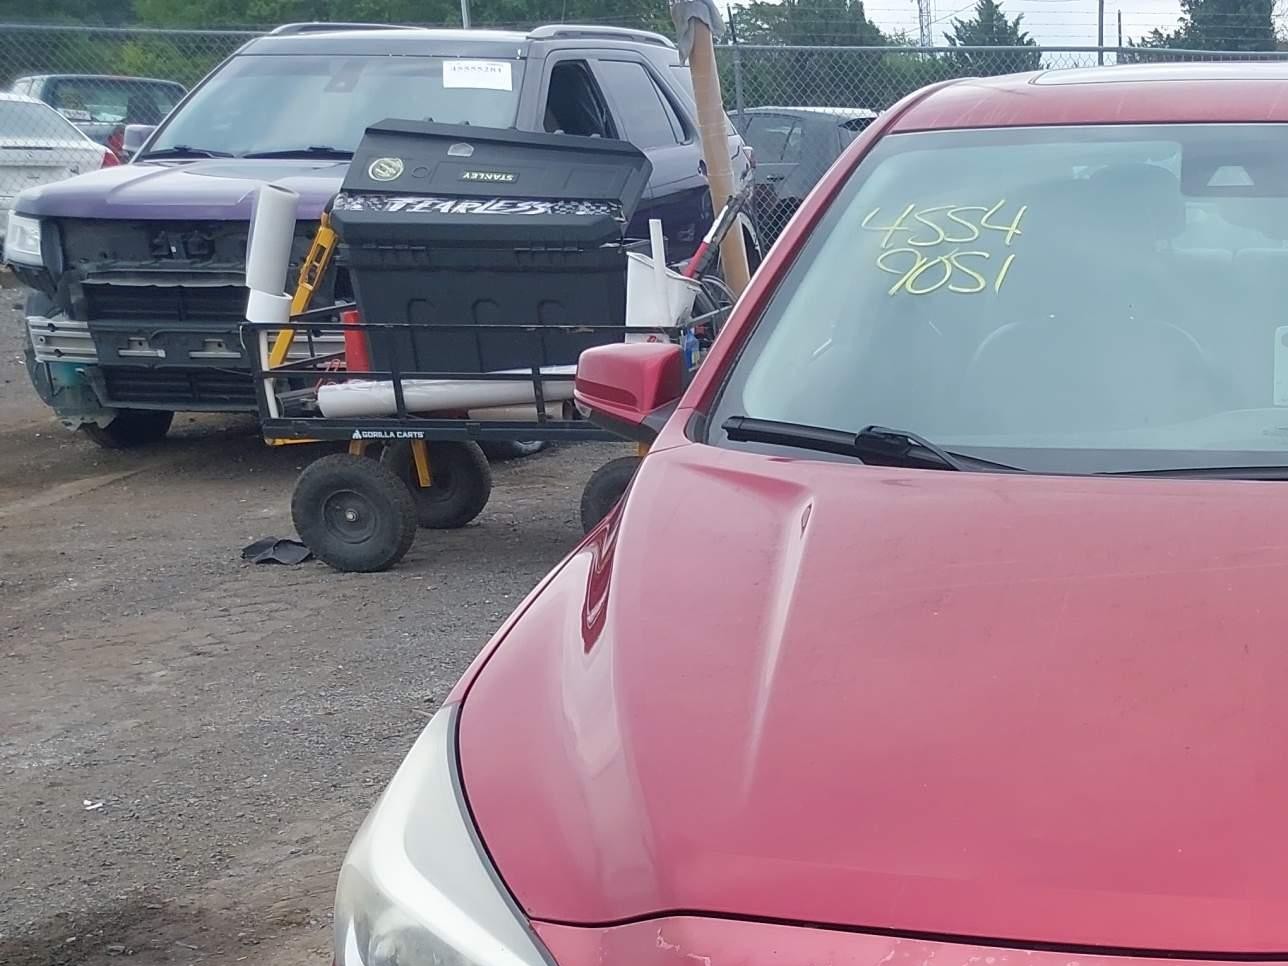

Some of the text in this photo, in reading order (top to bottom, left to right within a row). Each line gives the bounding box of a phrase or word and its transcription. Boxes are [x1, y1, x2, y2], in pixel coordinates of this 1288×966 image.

[462, 171, 514, 181] STANLEY
[861, 199, 1029, 249] 4554
[876, 247, 1016, 297] 9051
